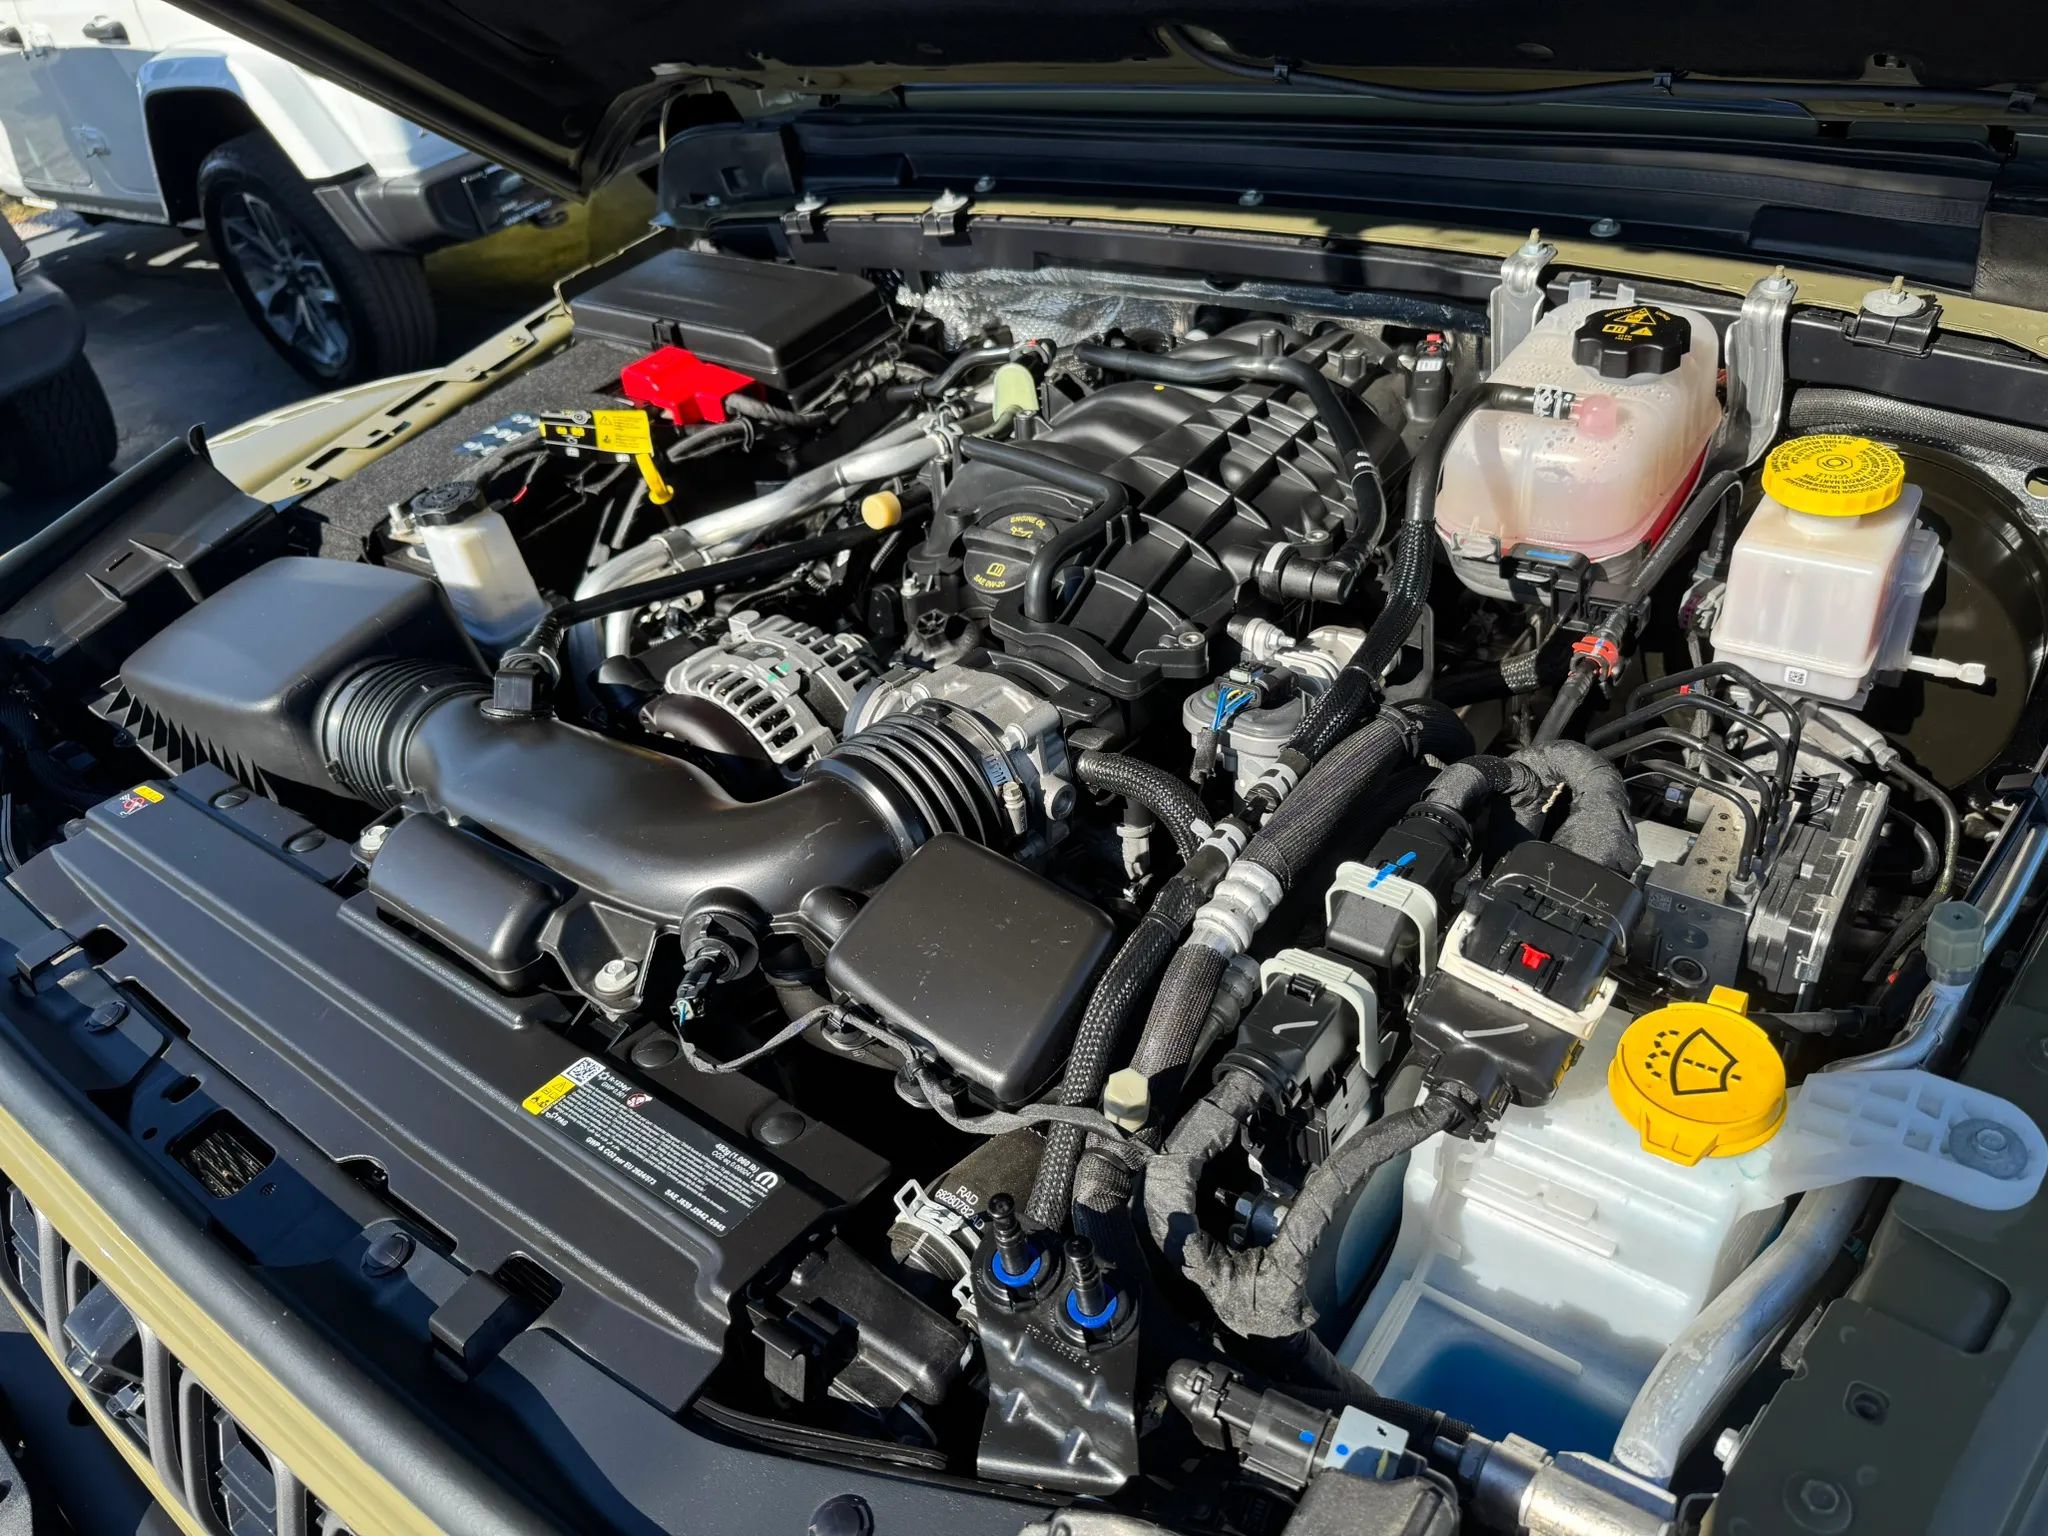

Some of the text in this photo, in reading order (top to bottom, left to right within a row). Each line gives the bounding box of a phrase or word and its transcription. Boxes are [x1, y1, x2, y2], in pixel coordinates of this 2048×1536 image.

[1010, 515, 1046, 529] ENGINE OIL
[974, 574, 1006, 588] SAE 0W-20
[585, 1137, 601, 1147] GWP
[613, 1157, 625, 1165] per
[623, 1161, 634, 1170] EU
[664, 1189, 679, 1200] SAE
[677, 1198, 692, 1209] J639
[956, 1186, 979, 1205] RAD
[935, 1189, 985, 1230] 68280782AD
